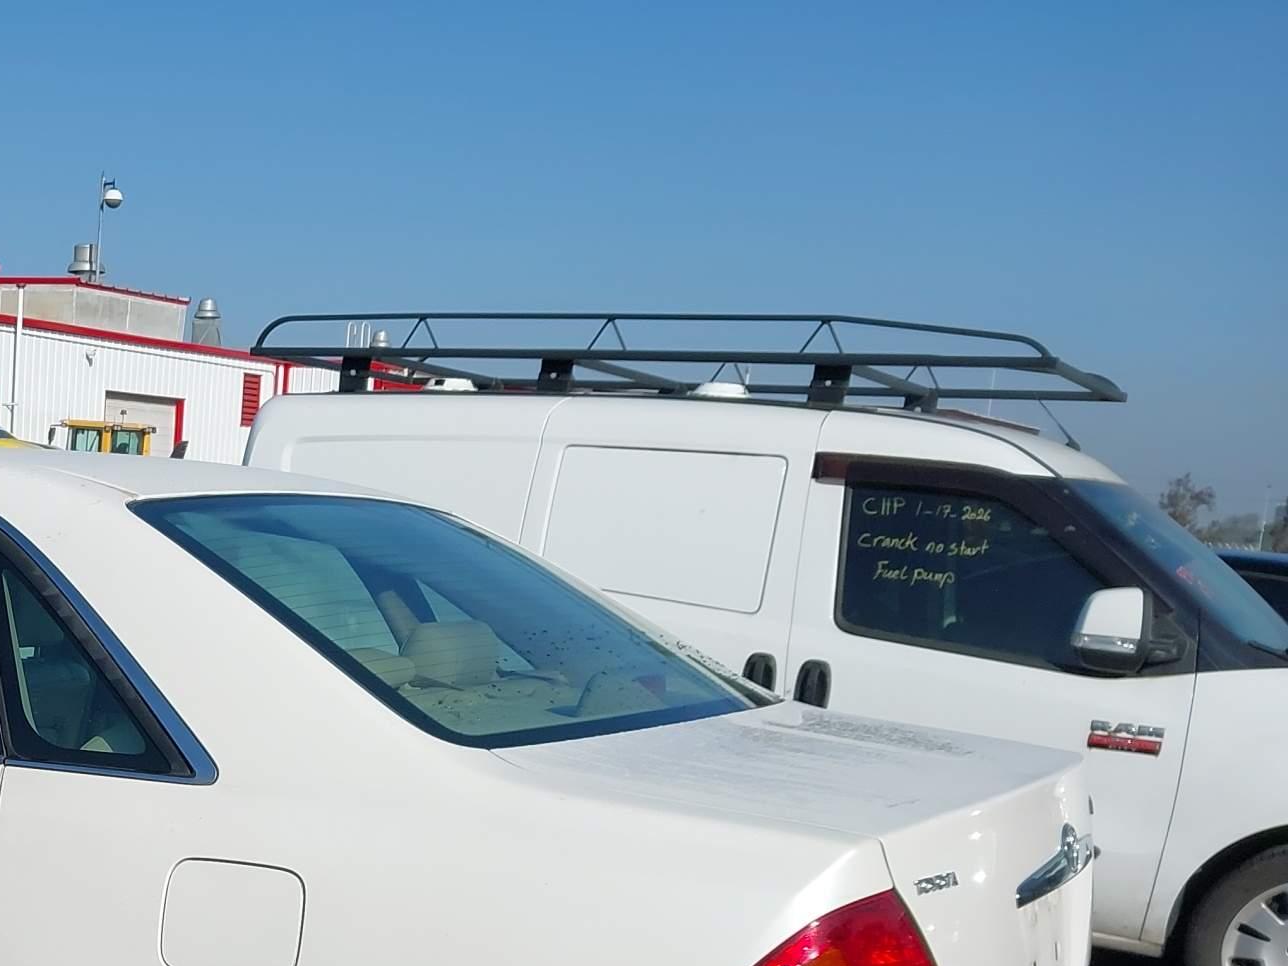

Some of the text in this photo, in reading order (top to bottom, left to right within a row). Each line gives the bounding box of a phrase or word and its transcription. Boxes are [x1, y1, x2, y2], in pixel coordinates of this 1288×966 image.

[925, 541, 944, 553] no
[947, 539, 989, 556] start
[873, 561, 955, 588] Fuel pump
